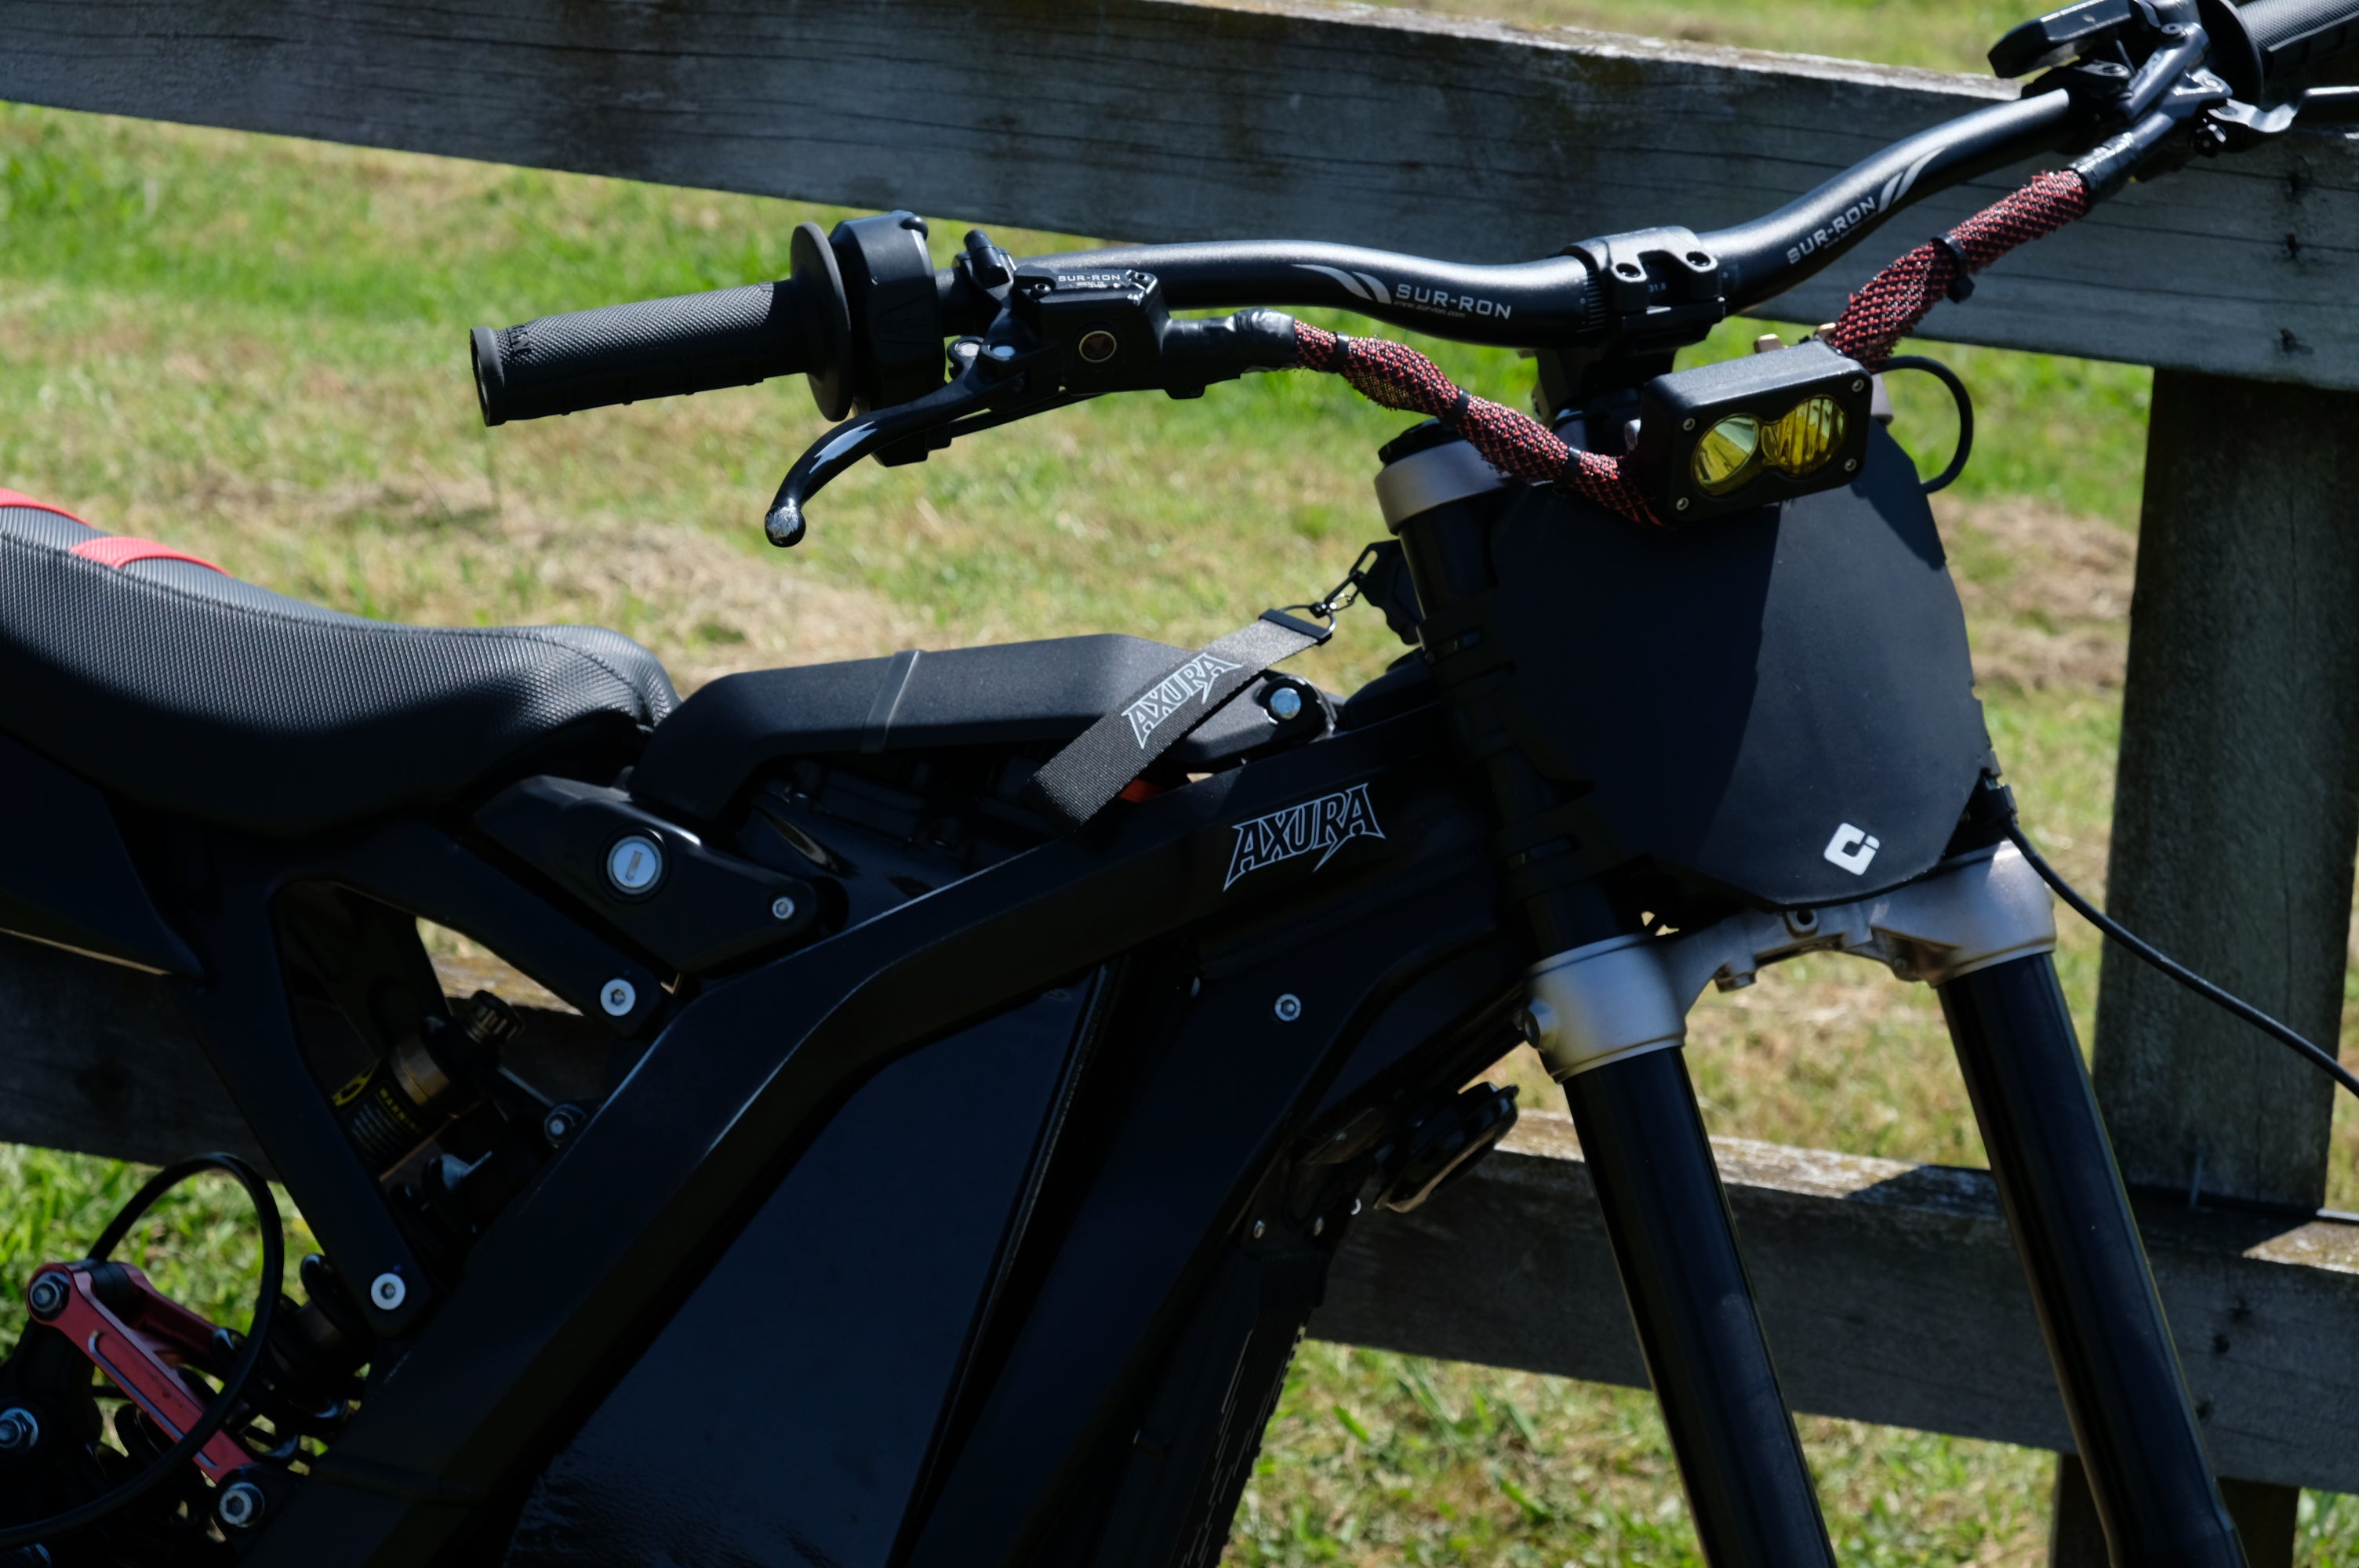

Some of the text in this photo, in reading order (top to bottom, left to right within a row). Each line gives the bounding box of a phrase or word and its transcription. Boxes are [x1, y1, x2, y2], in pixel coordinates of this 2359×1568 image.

[1787, 196, 1876, 264] SUR-RON
[1058, 274, 1121, 282] SUR-RON
[1395, 283, 1511, 320] SUR-RON
[1121, 652, 1243, 750] AXURA
[1223, 782, 1386, 891] AXURA
